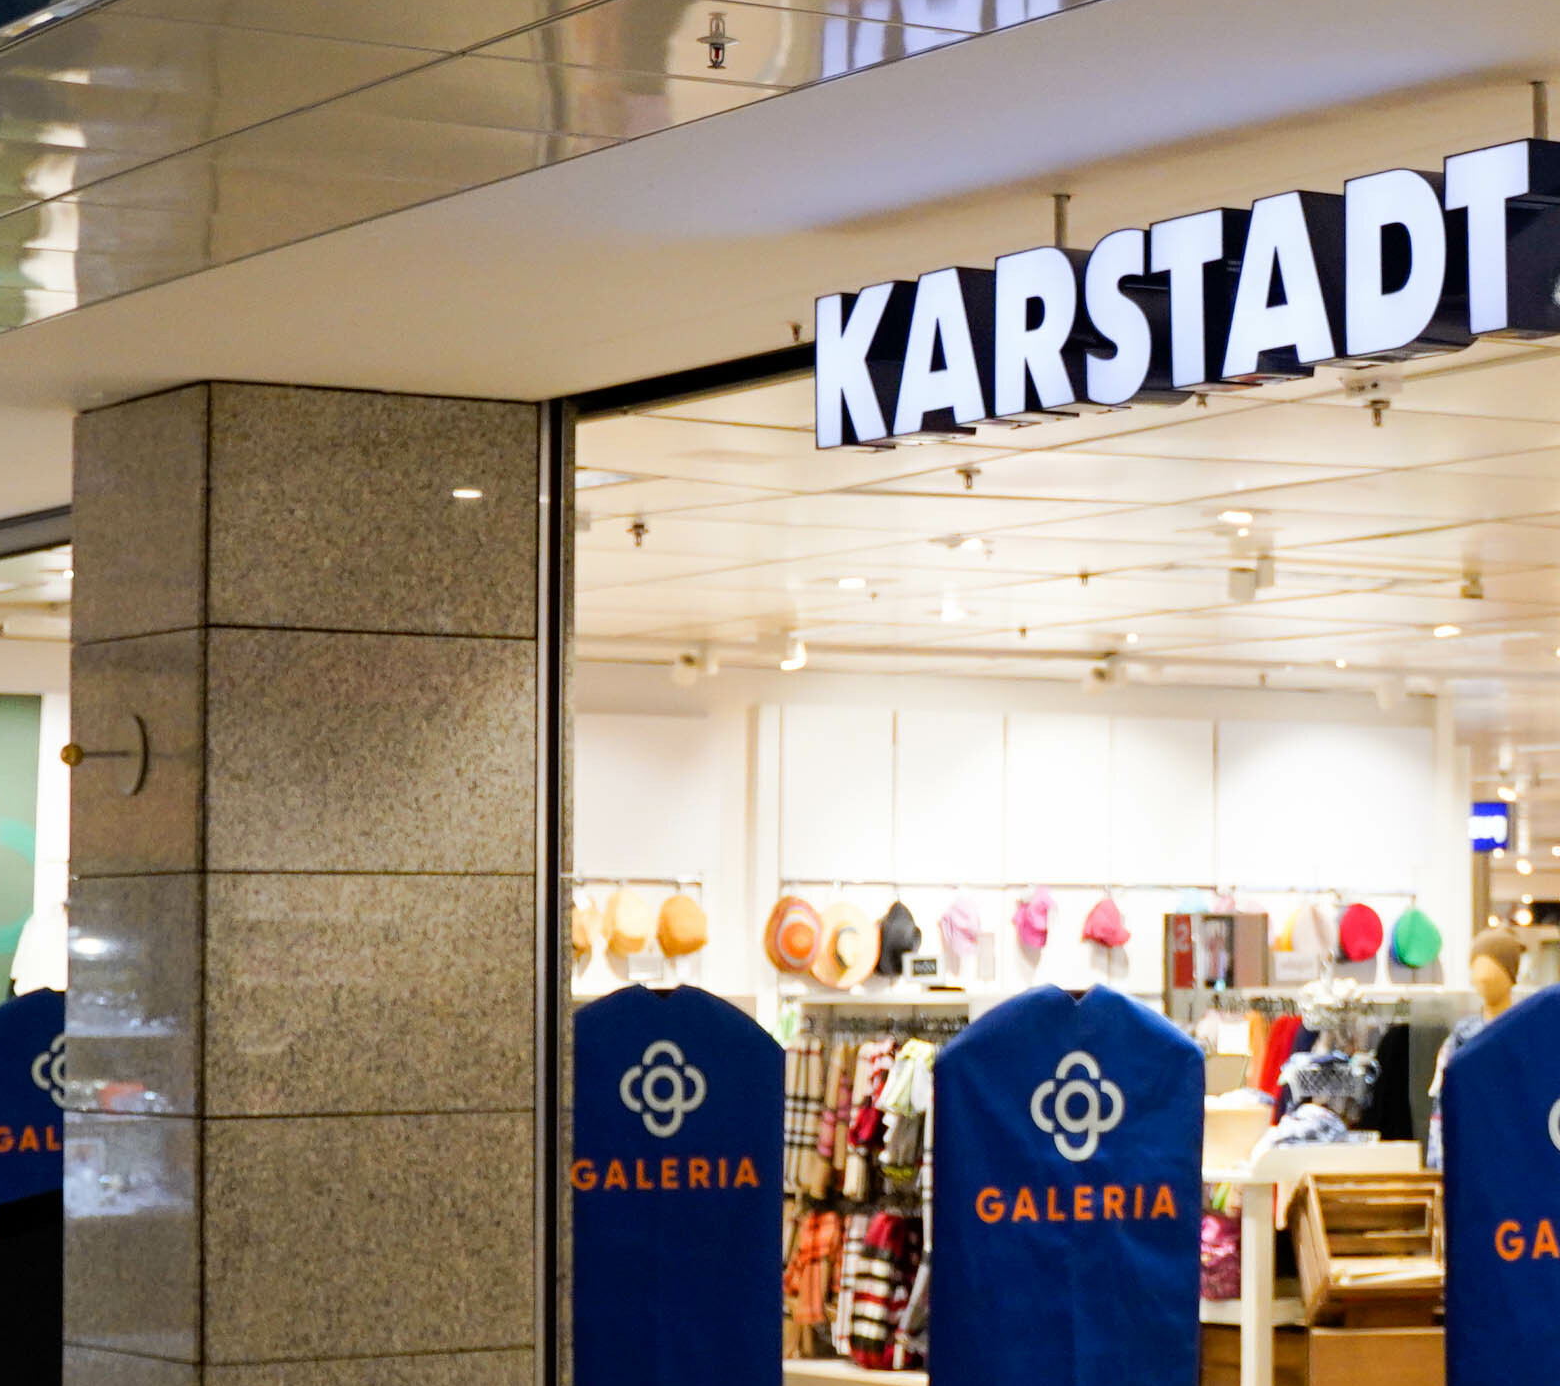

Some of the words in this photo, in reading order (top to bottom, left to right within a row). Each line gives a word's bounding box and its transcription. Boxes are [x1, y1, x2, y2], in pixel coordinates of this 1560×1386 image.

[815, 139, 1530, 451] KARSTADT
[571, 1157, 759, 1190] GALERIA
[975, 1183, 1178, 1224] GALERIA
